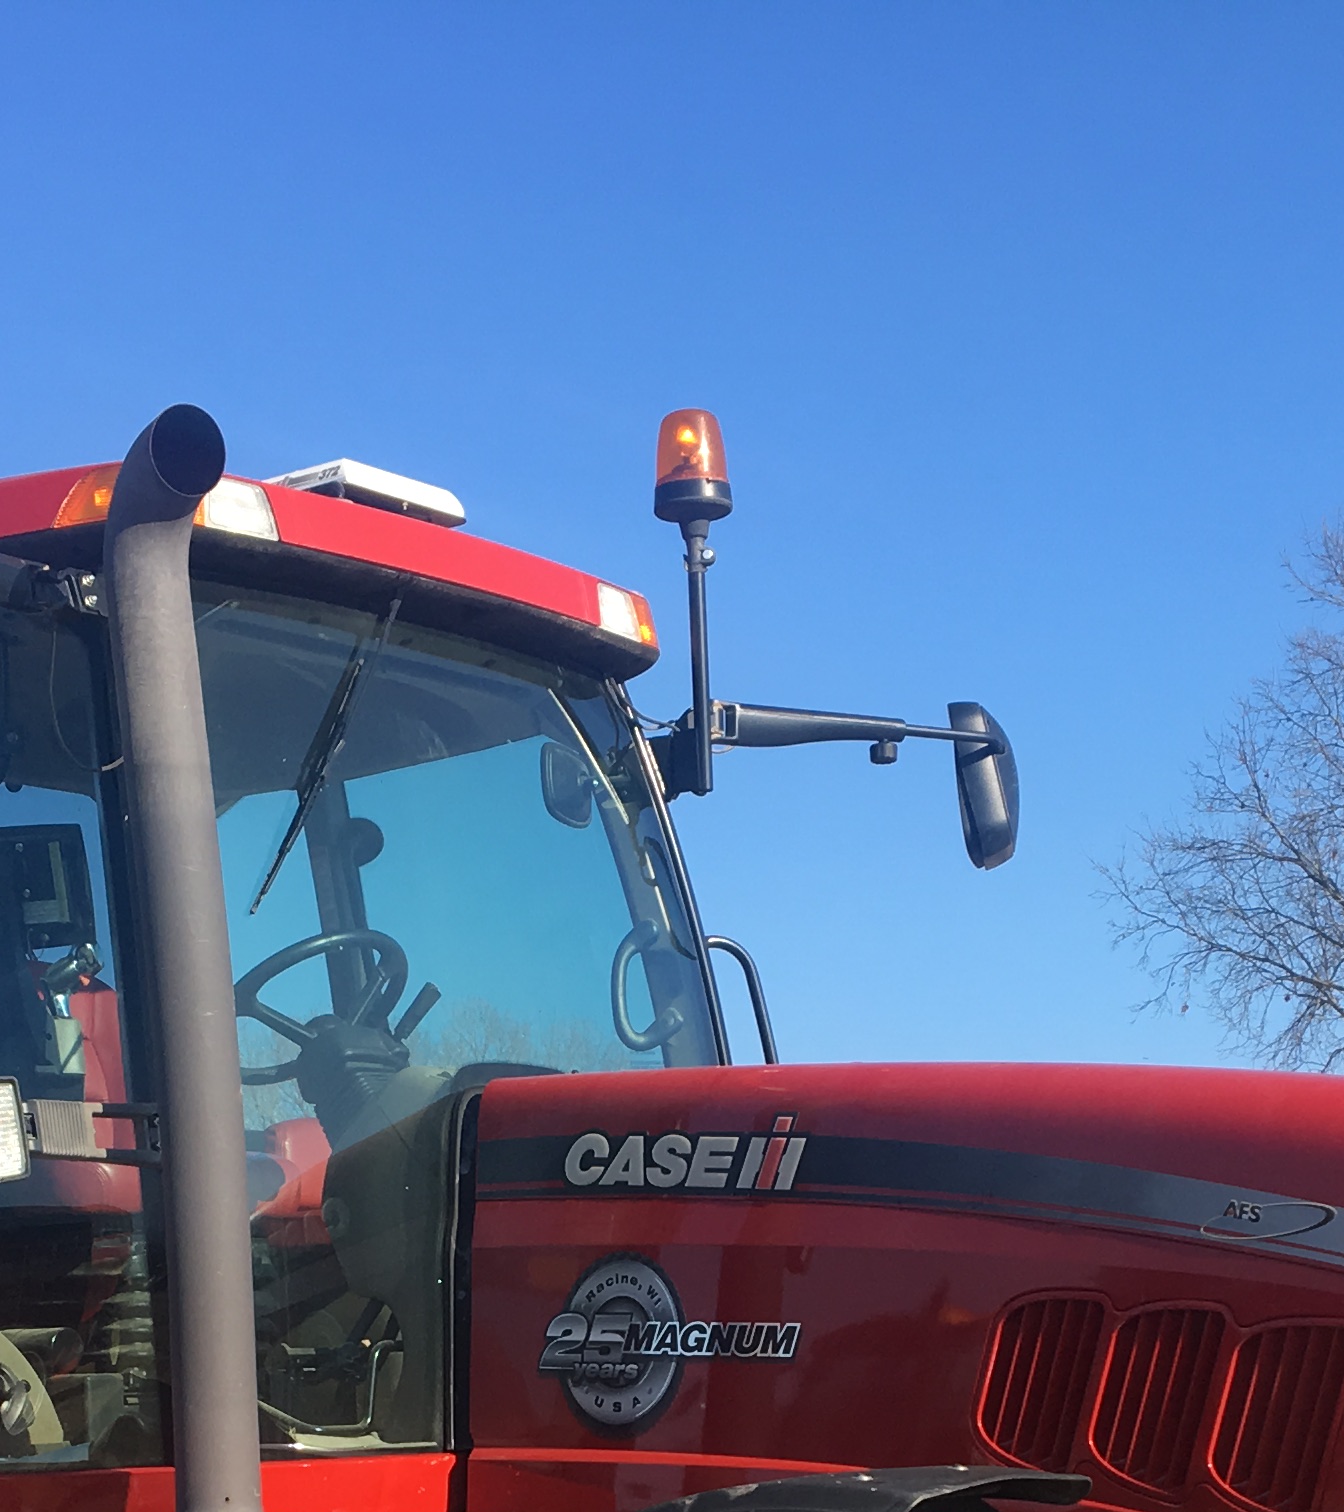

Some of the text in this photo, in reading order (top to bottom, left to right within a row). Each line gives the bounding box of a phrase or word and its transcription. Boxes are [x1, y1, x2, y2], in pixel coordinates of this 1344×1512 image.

[565, 1133, 740, 1190] CASE
[1222, 1200, 1263, 1223] AFS
[585, 1272, 643, 1303] Racine,
[538, 1312, 802, 1370] 25 MAGNUM
[572, 1360, 639, 1388] years
